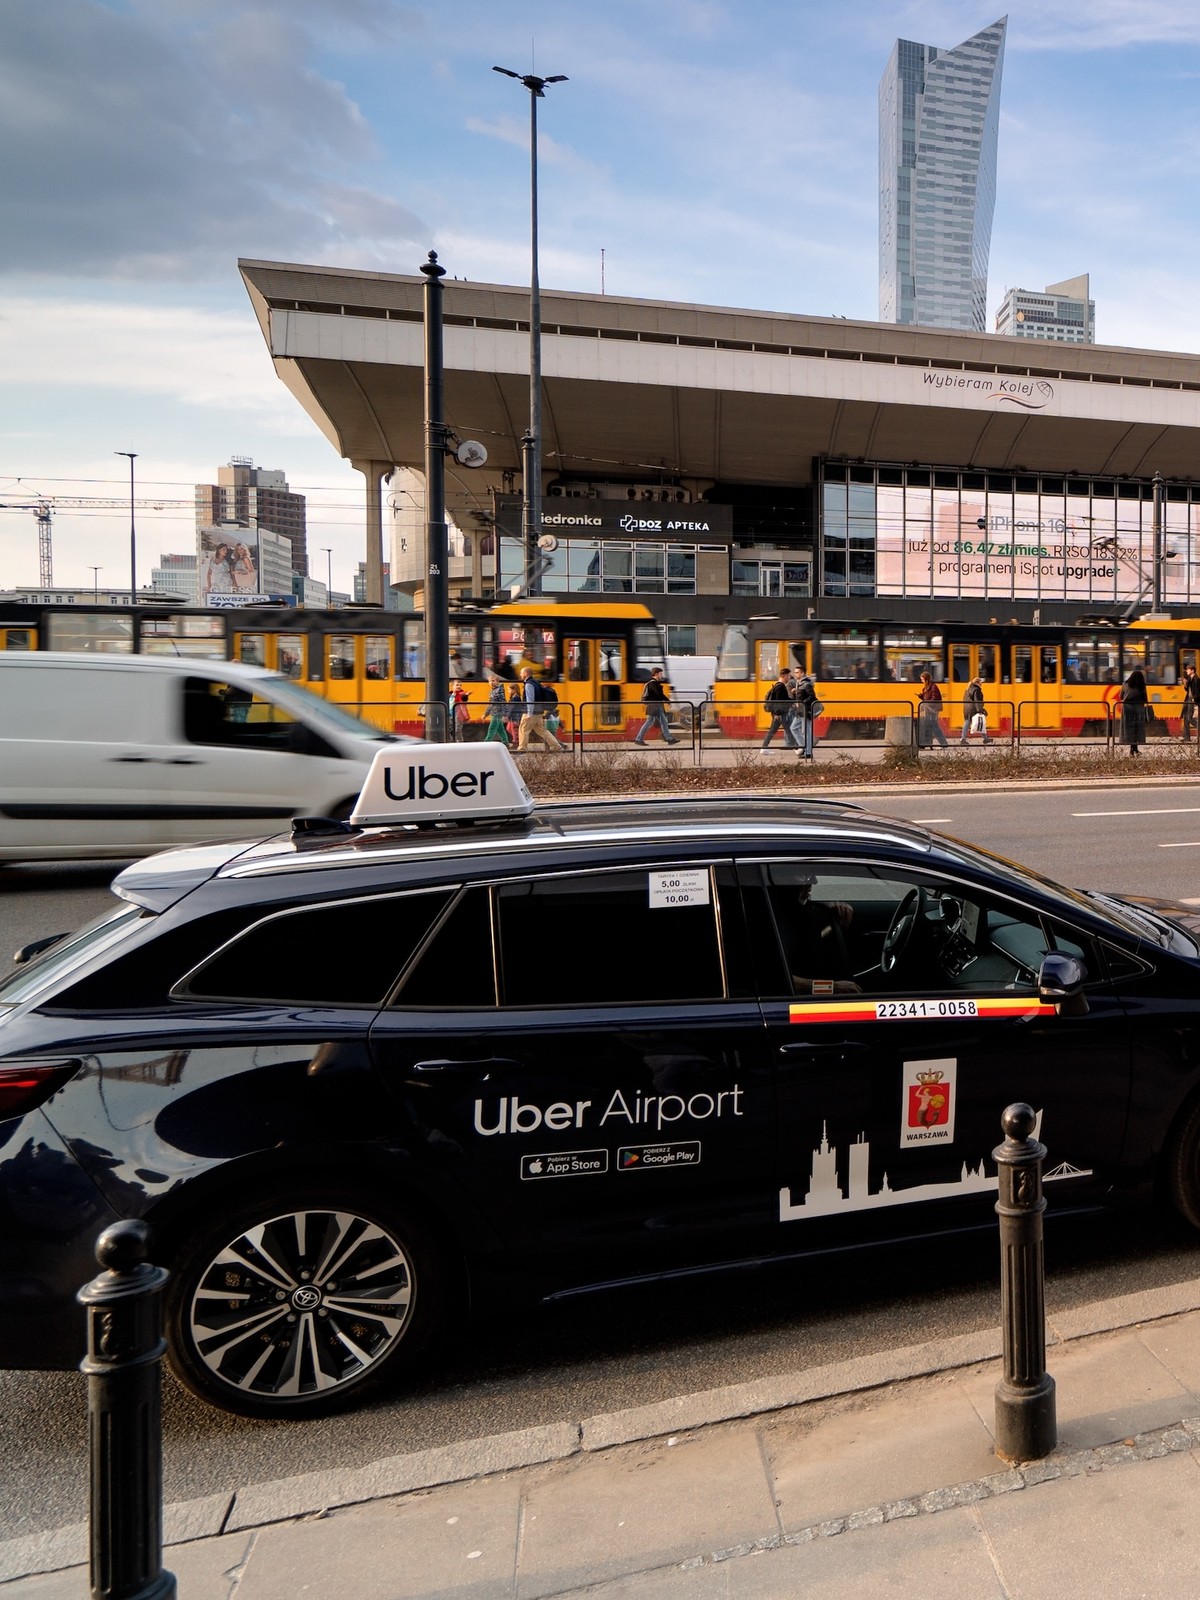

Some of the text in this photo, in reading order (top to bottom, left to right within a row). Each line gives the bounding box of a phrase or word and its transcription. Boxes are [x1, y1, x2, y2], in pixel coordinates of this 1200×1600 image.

[923, 372, 1034, 397] Wybieram Kolej
[541, 512, 602, 526] iedronka
[639, 520, 710, 531] DOZ APTEKA
[990, 516, 1046, 533] iPhone
[908, 539, 928, 554] już
[933, 541, 950, 552] od
[1053, 545, 1091, 558] RRSO
[939, 561, 1017, 576] programem
[1020, 562, 1054, 578] iSpot
[384, 765, 495, 801] Uber
[661, 880, 680, 888] 5,00
[665, 895, 689, 903] 10,00
[878, 1001, 977, 1018] 22341-0058
[474, 1084, 744, 1136] Uber Airport
[906, 1130, 949, 1141] WARSZAWA
[547, 1155, 570, 1163] Pobierz
[643, 1151, 695, 1164] Google Play
[546, 1160, 601, 1174] App Store
